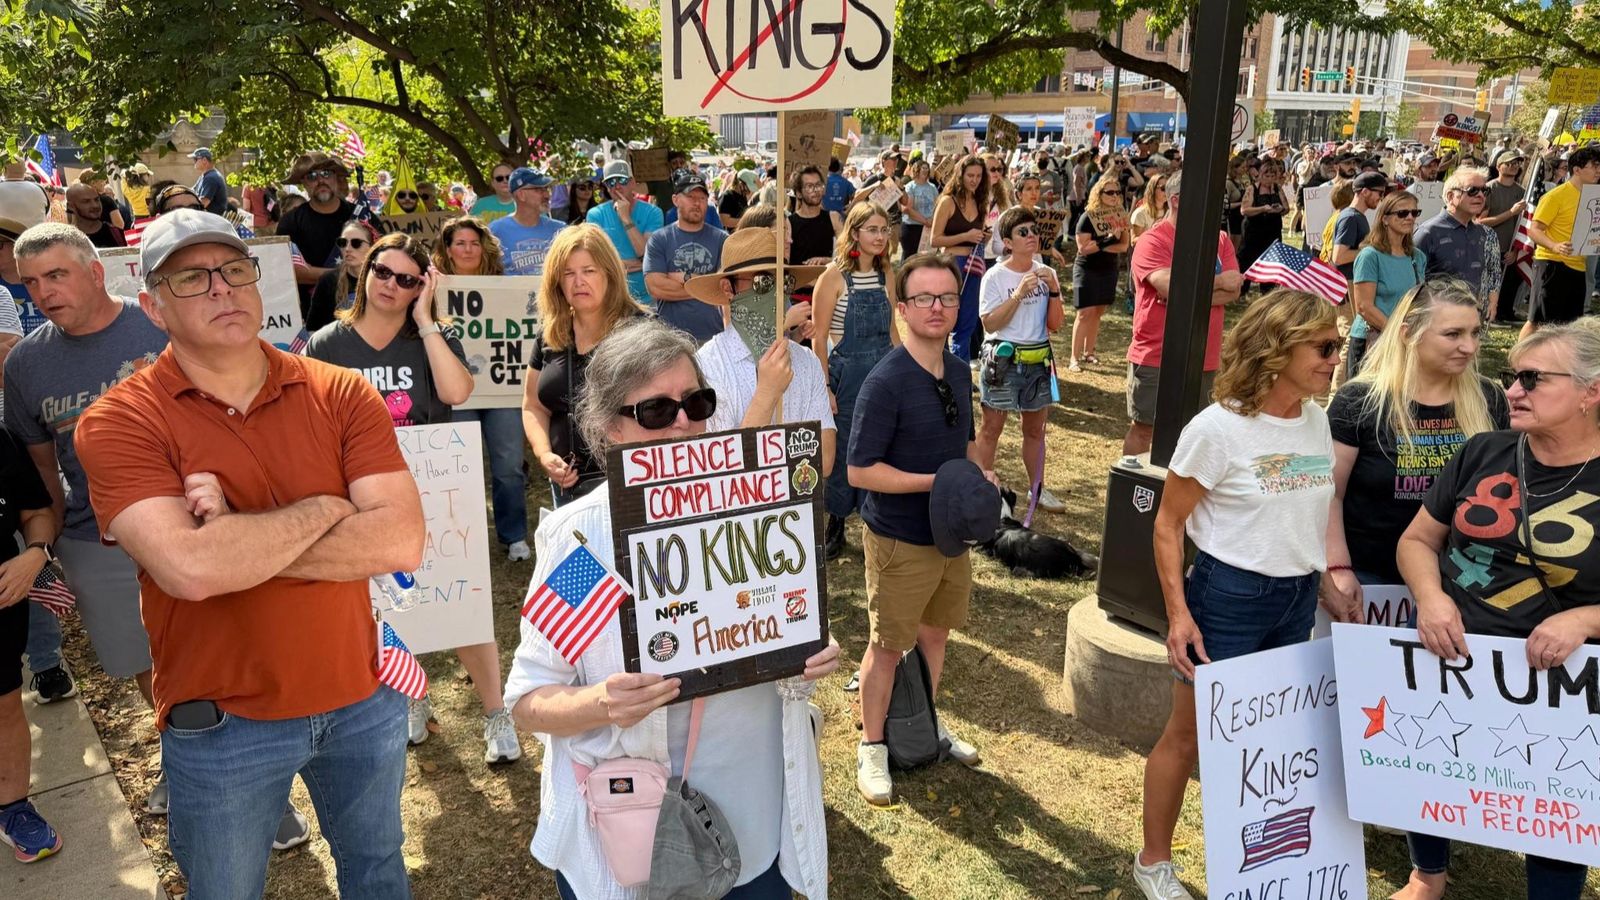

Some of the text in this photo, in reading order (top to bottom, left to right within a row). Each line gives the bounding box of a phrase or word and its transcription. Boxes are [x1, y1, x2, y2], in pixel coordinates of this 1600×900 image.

[671, 0, 892, 80] KINGS
[1464, 116, 1476, 125] NO
[447, 290, 484, 317] NO
[453, 317, 542, 340] SOLDI
[490, 340, 523, 363] IN
[350, 366, 414, 391] IRLS
[42, 391, 90, 423] GULF
[791, 430, 812, 444] NO
[1419, 418, 1441, 430] LIVES
[396, 428, 466, 454] RICA
[788, 441, 818, 454] TRUMP
[1438, 444, 1450, 456] IS
[425, 459, 450, 480] Have
[451, 454, 470, 474] To
[629, 432, 784, 485] SILENCE IS
[1396, 455, 1427, 469] NEWS
[649, 468, 787, 520] COMPLIANCE
[1395, 475, 1431, 492] LOVE
[1454, 472, 1600, 558] 86
[423, 526, 470, 560] ACY
[636, 510, 808, 601] NO KINGS
[655, 600, 699, 621] NOPE
[752, 594, 776, 607] IDIOT
[785, 613, 809, 624] TRUMP
[692, 613, 784, 656] America
[1209, 674, 1338, 743] RESISTING
[1238, 747, 1319, 807] KINGS
[1360, 748, 1600, 801] Based on 328 Million Revi
[1469, 788, 1581, 820] VERY BAD
[1421, 801, 1600, 846] NOT RECOMM
[1307, 862, 1351, 900] 1776
